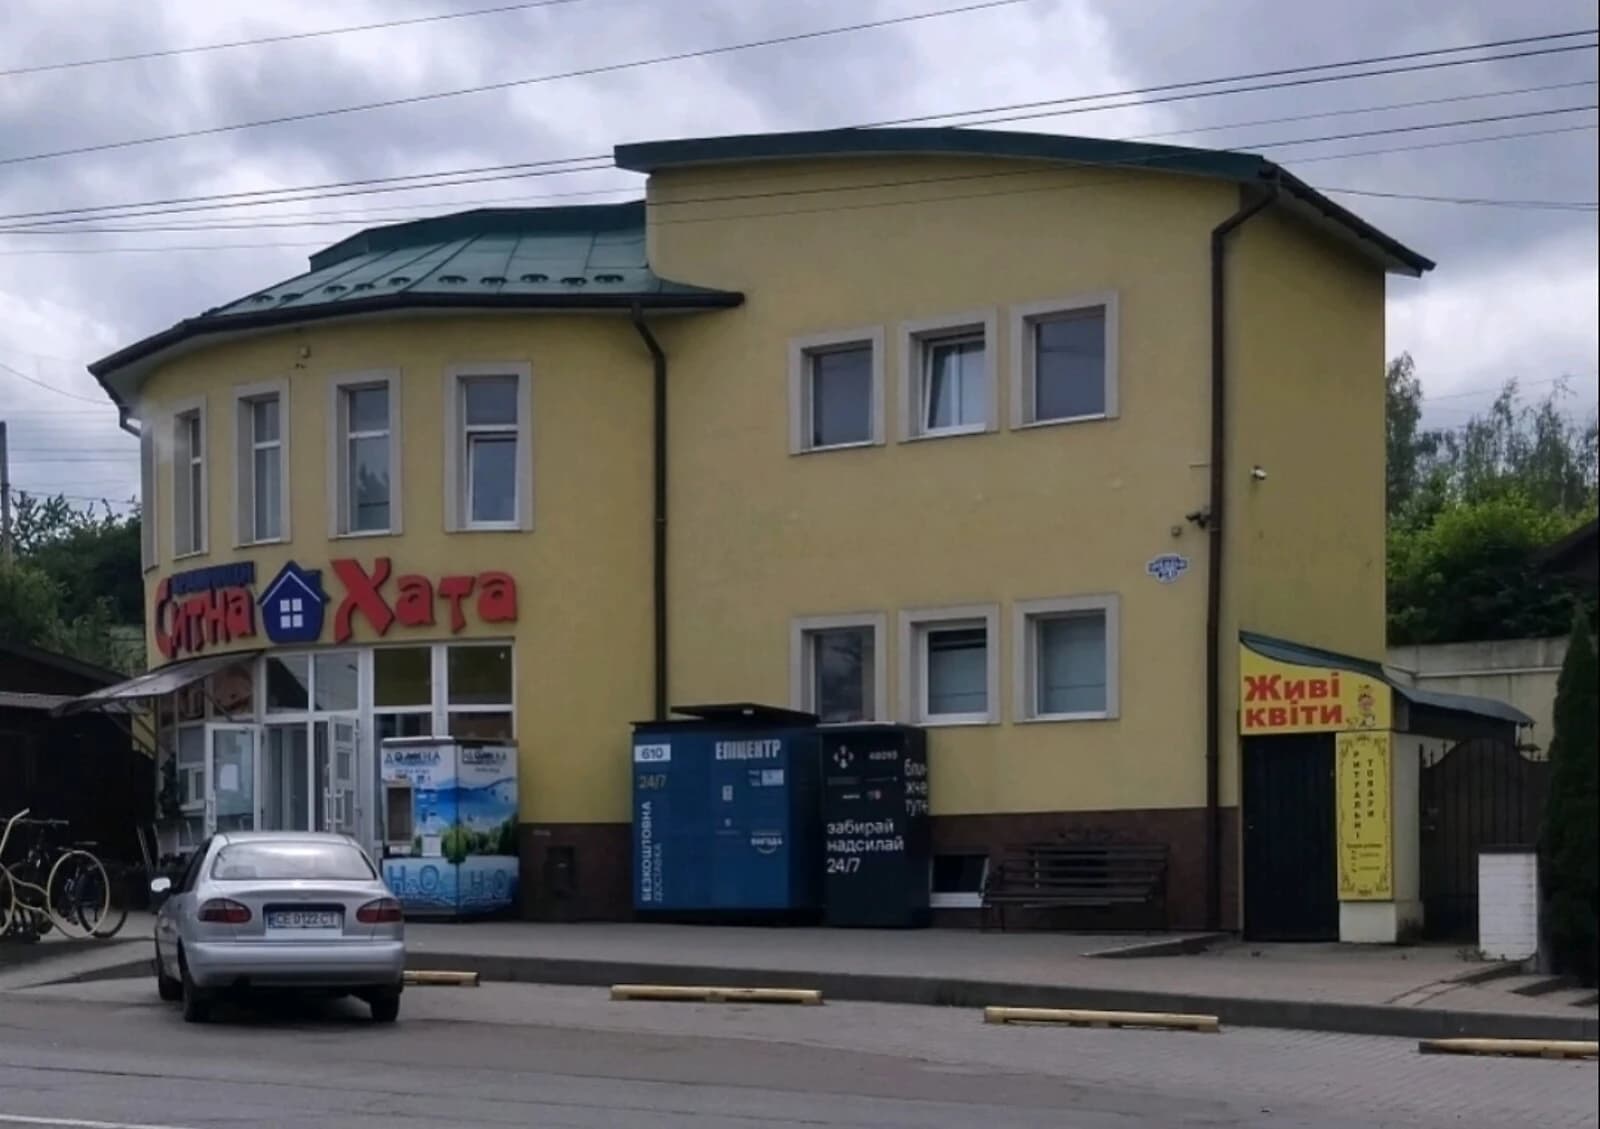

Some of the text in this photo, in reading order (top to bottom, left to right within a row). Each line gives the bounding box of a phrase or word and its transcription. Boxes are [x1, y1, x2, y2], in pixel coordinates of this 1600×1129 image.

[330, 557, 518, 645] Хата
[1244, 672, 1341, 702] Живі
[1245, 699, 1343, 729] квіти
[641, 747, 664, 759] 610
[715, 739, 781, 760] ЕПІЦЕНТР
[826, 818, 895, 837] забирай
[641, 801, 652, 902] БЕЗКОШТОВНА
[826, 835, 905, 853] надсилай
[826, 857, 861, 874] 24/7
